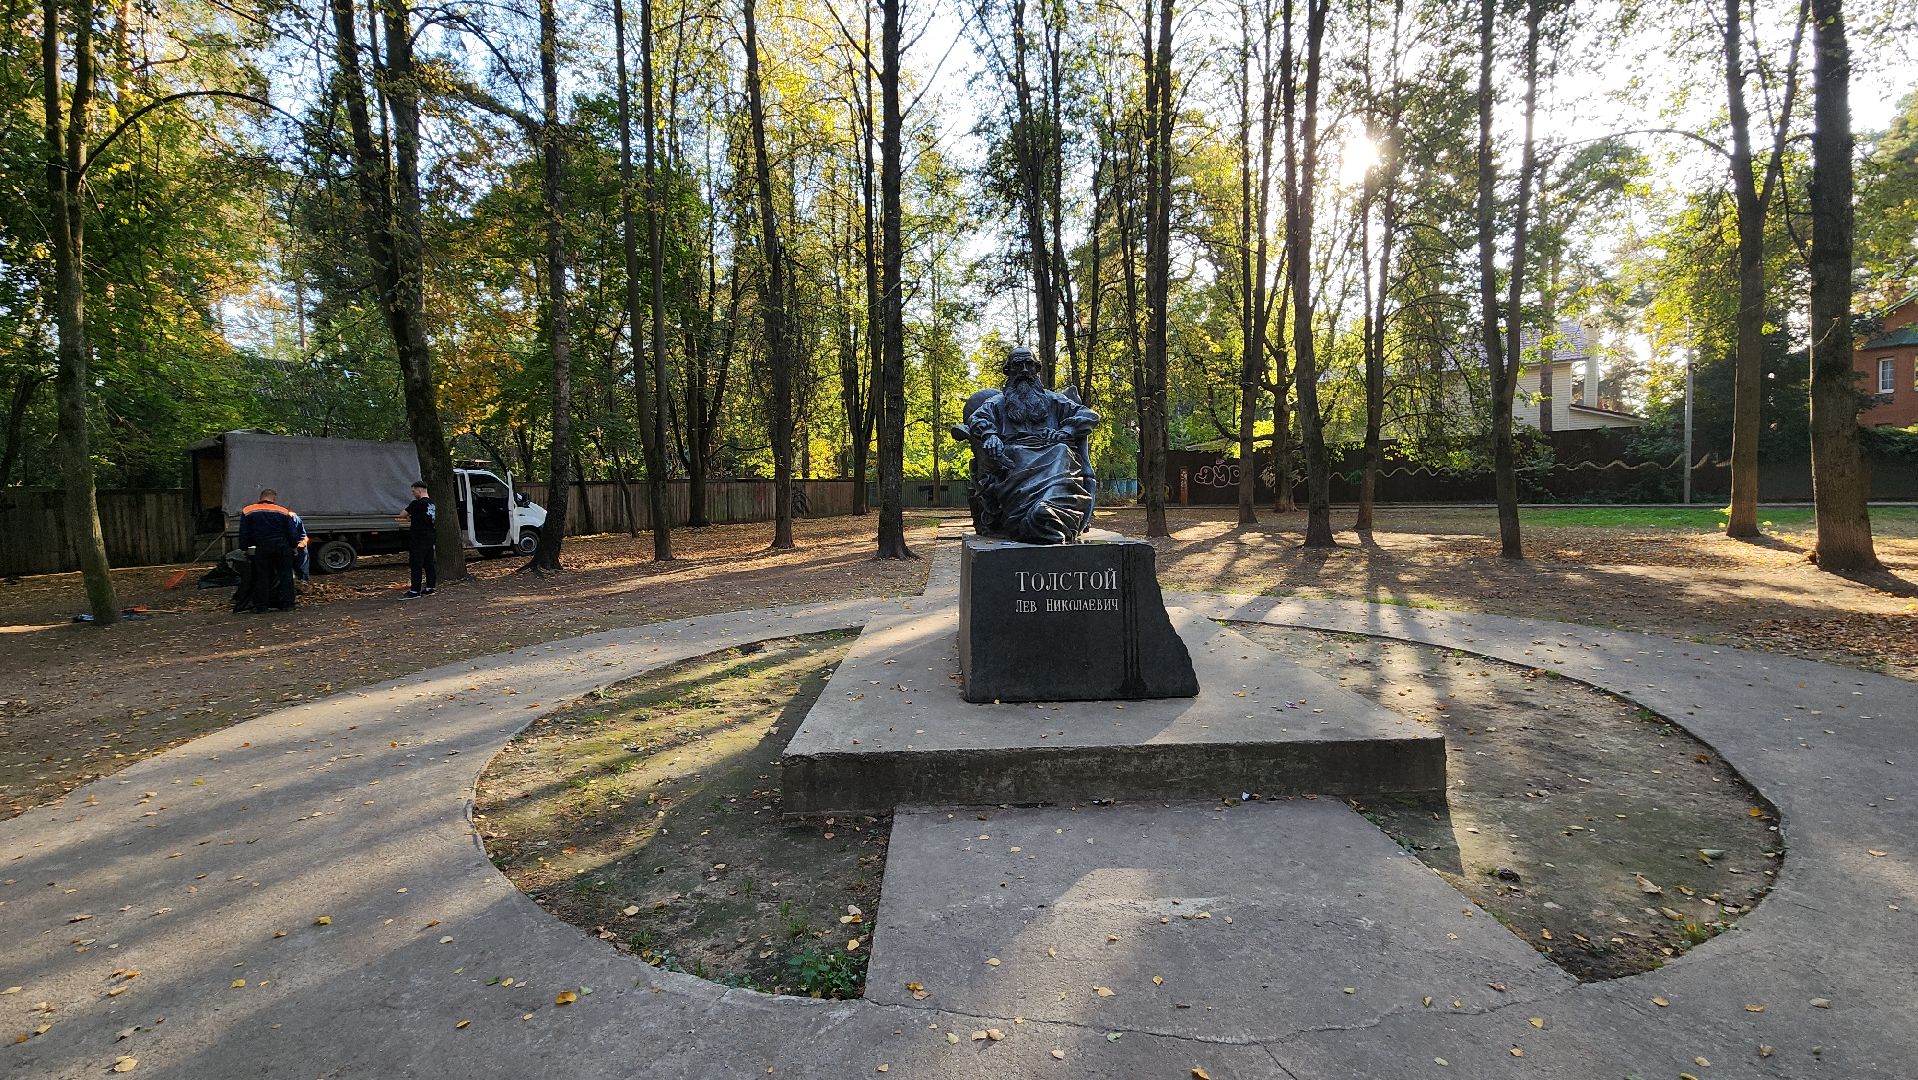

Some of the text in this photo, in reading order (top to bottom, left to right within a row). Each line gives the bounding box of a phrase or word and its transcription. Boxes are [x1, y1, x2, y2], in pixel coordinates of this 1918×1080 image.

[1015, 568, 1118, 592] ТОЛСТОЙ
[1015, 598, 1119, 613] ЛЕВ НИКОЛАЕВИЧ
